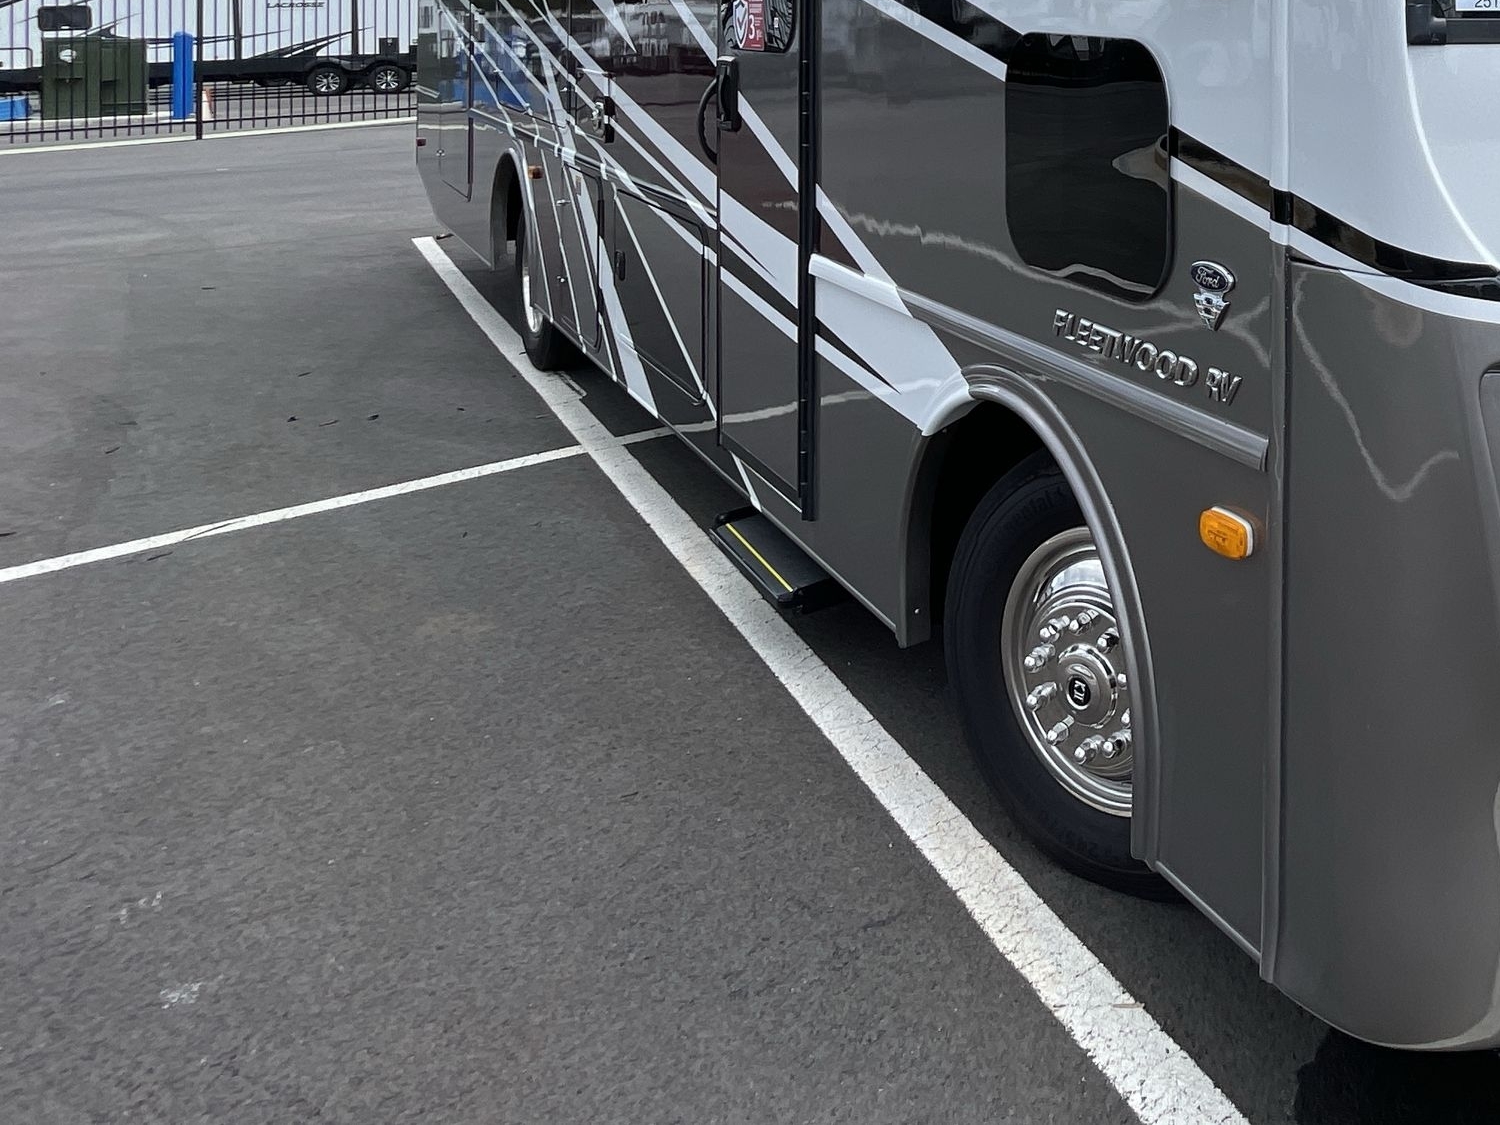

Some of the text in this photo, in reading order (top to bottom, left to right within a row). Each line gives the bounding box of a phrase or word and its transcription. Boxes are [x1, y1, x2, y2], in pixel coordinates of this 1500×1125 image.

[748, 14, 755, 40] 3
[1195, 266, 1220, 288] Ford
[1052, 308, 1244, 405] FLEETWOOD RV
